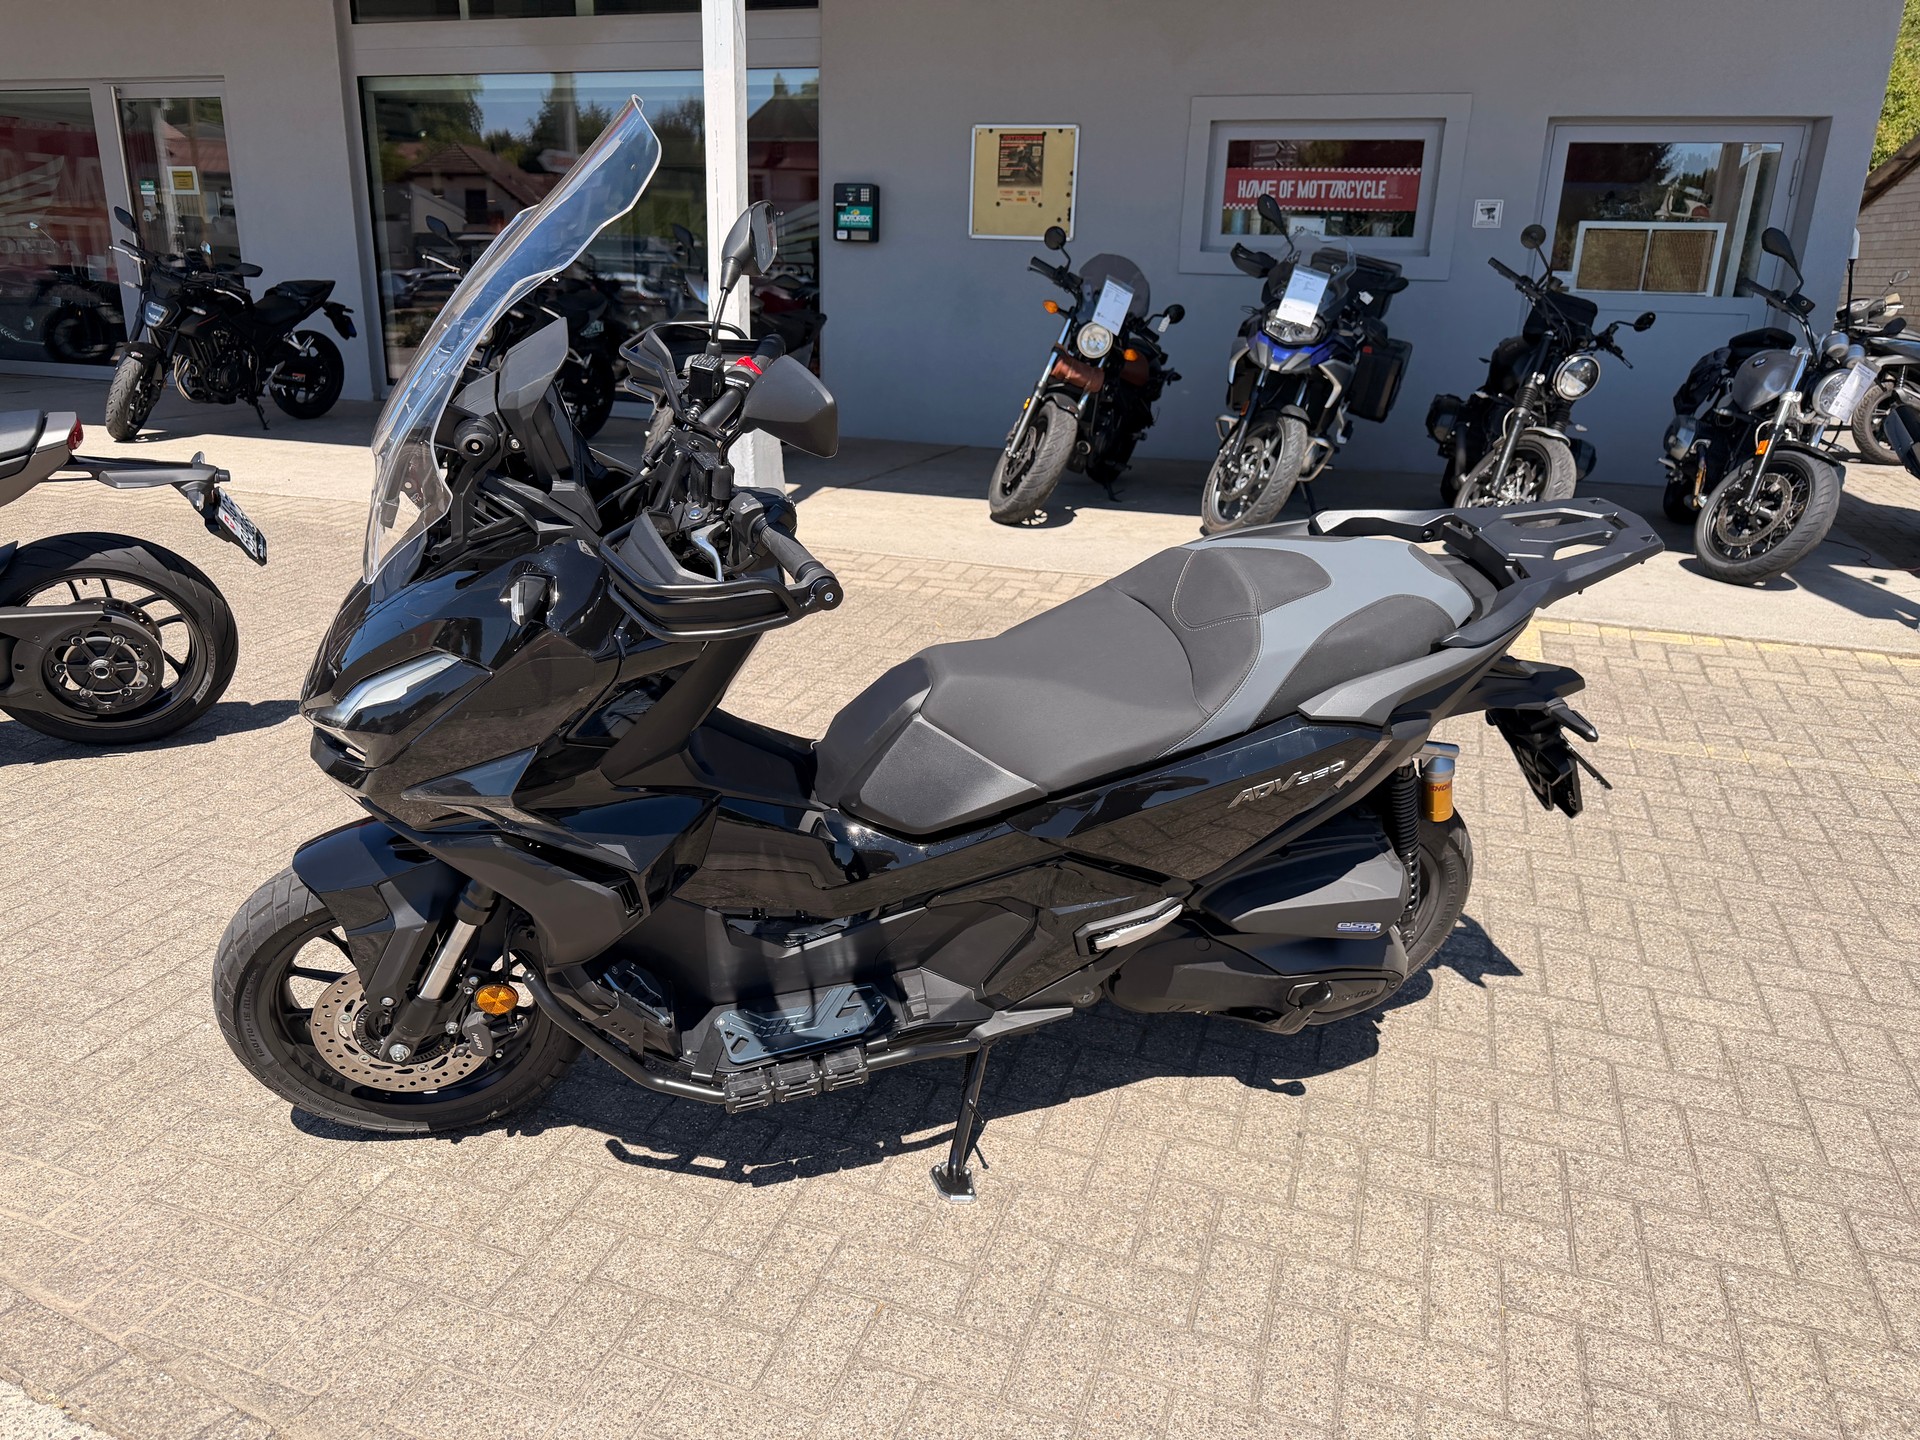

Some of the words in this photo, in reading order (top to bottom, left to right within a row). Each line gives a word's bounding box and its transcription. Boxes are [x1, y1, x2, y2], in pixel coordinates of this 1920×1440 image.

[1237, 179, 1277, 198] HOME
[1278, 179, 1296, 199] OF
[1296, 179, 1388, 199] MOTORCYCLE
[840, 214, 871, 222] MOTOREX
